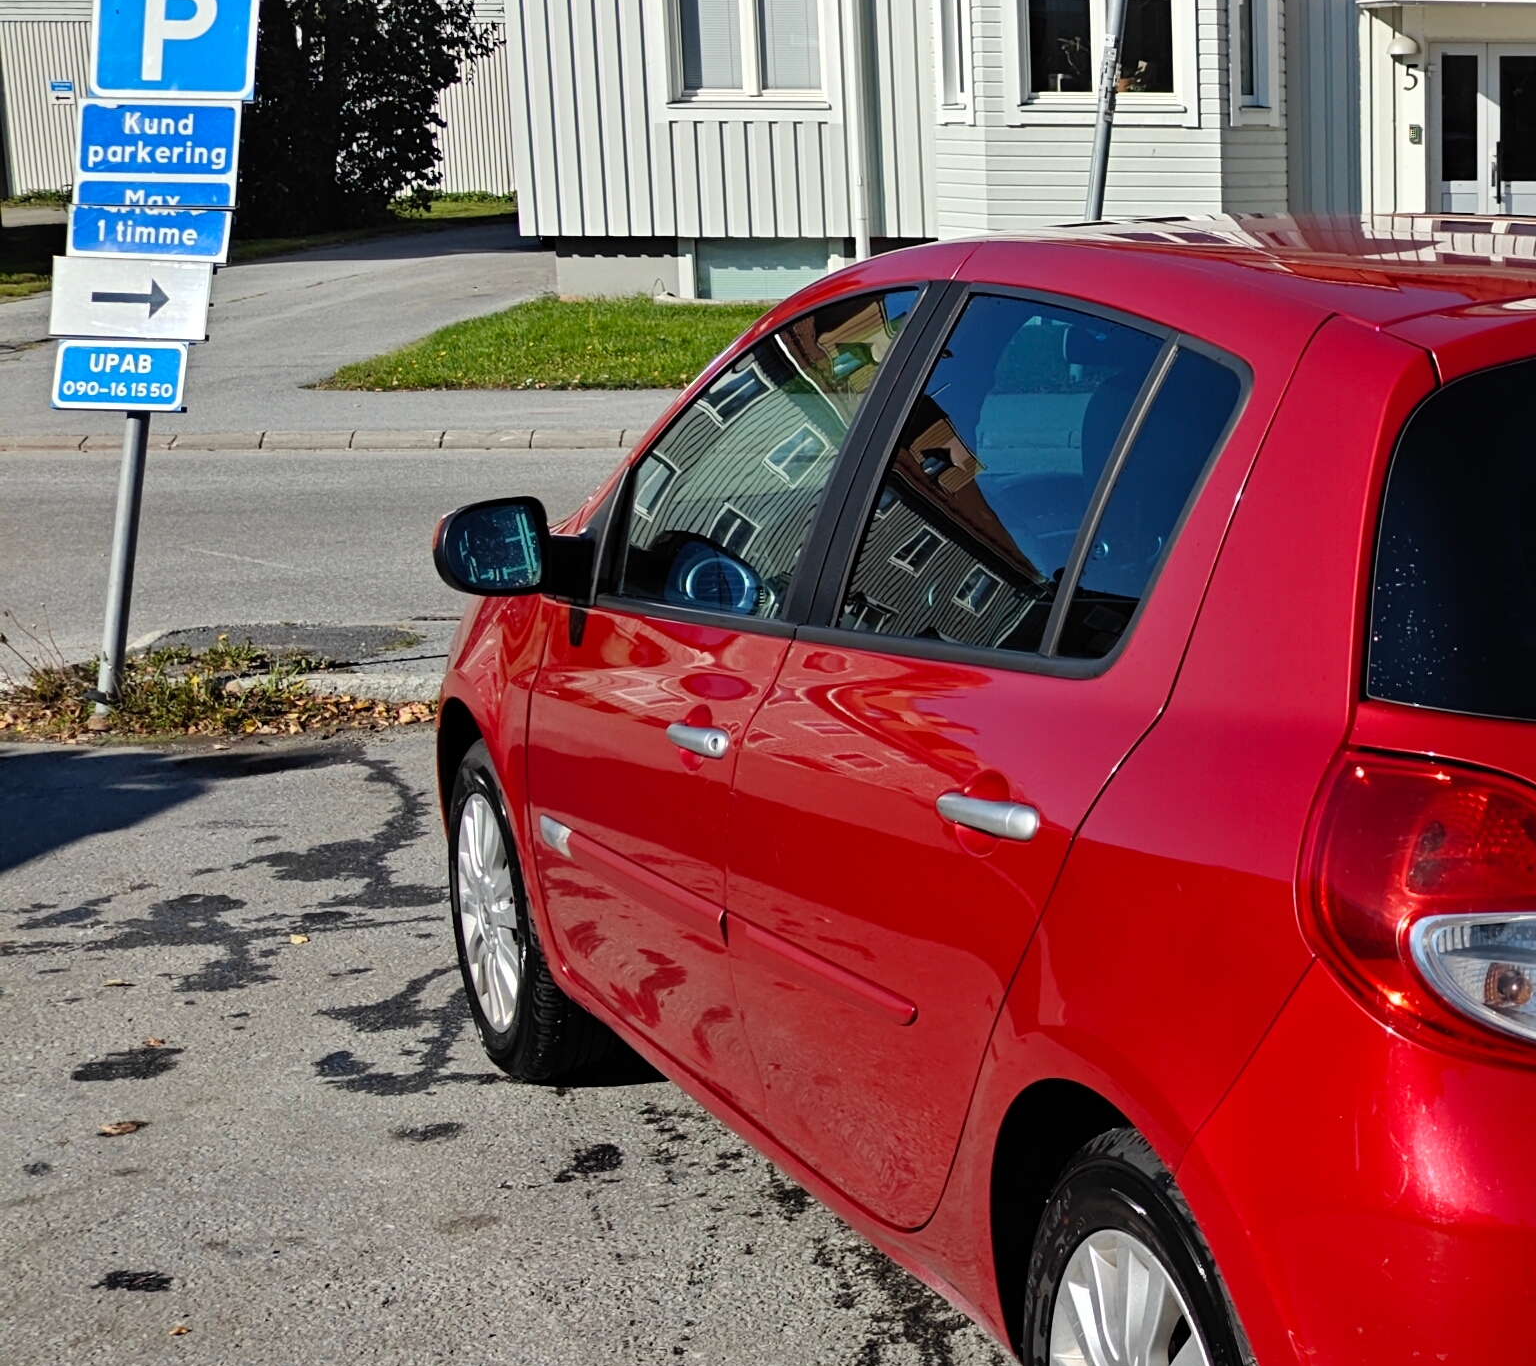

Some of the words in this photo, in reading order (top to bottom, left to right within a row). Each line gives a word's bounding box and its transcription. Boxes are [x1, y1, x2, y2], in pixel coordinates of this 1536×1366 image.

[1402, 63, 1419, 91] 5
[123, 111, 194, 135] Kund
[87, 140, 227, 170] parkering
[97, 219, 106, 242] 1
[116, 220, 198, 246] timme
[89, 353, 152, 374] UPAB
